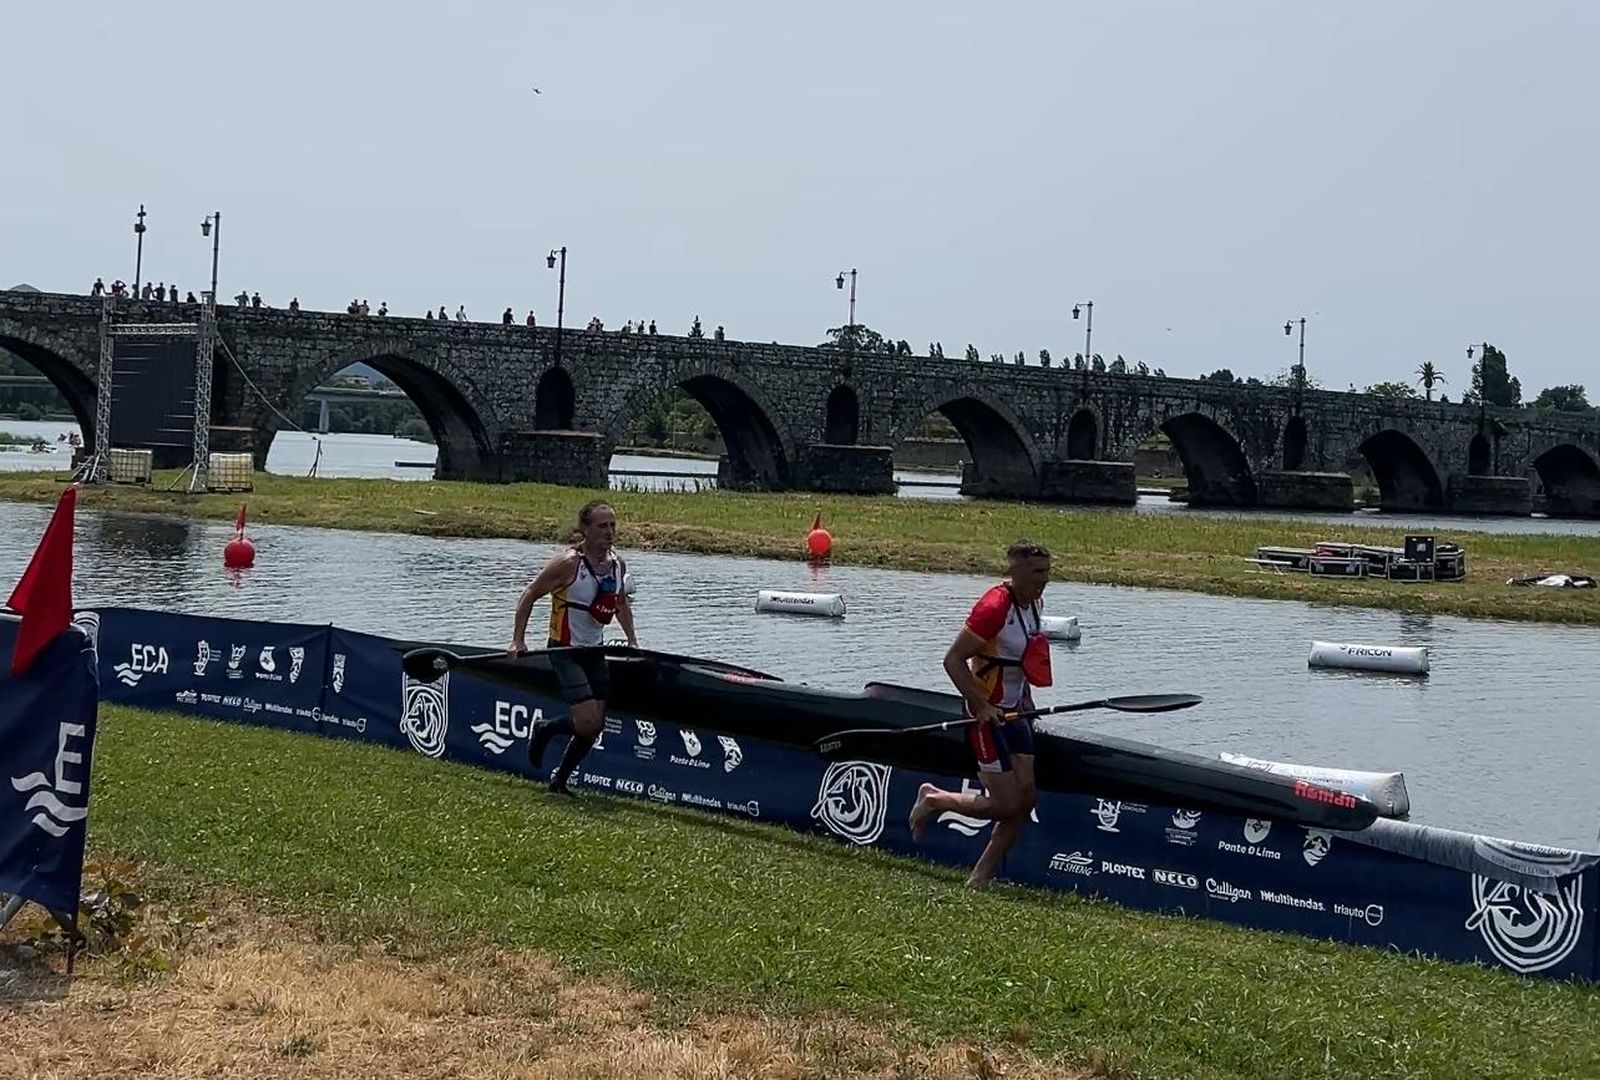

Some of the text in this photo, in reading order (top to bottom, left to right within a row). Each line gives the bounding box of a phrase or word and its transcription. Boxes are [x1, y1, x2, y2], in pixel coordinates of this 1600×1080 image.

[131, 643, 169, 674] ECA
[1347, 646, 1392, 657] FRICON
[1218, 840, 1246, 854] Ponte
[1255, 846, 1281, 860] Lima
[1154, 871, 1197, 887] NELO
[1205, 878, 1252, 903] Culligan
[1334, 903, 1364, 918] triauto
